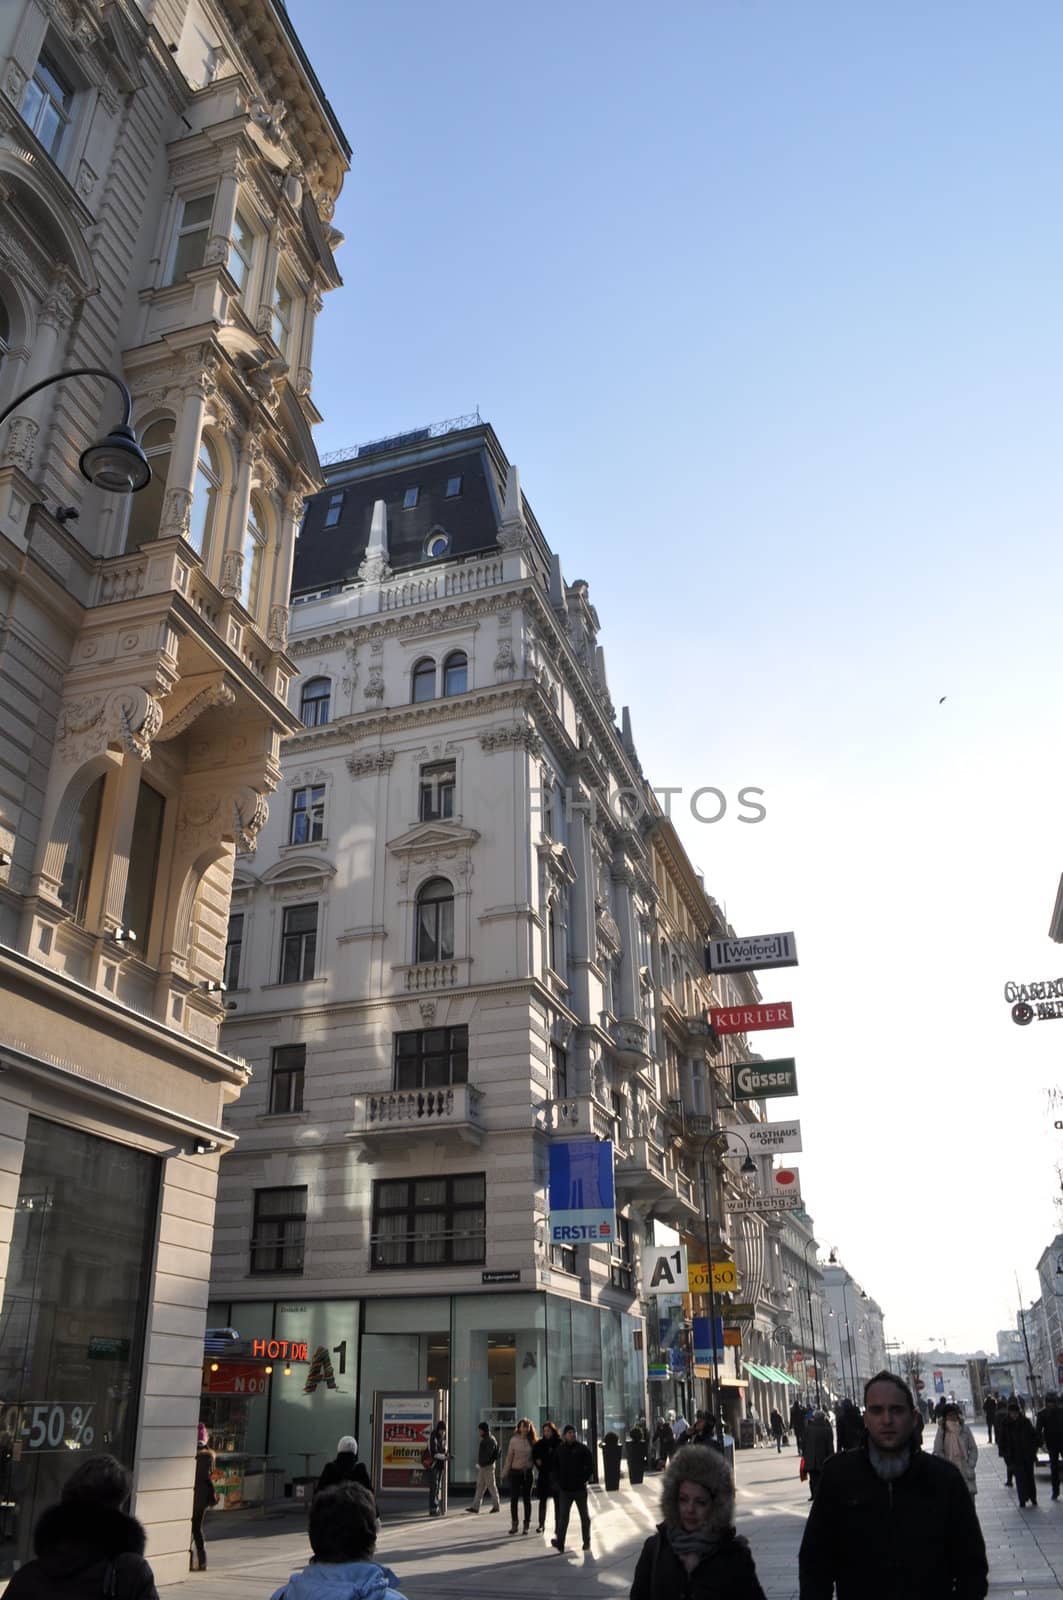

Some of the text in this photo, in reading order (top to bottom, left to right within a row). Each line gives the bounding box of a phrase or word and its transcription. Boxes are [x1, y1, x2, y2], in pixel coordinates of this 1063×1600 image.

[729, 943, 777, 957] Wolford
[716, 1008, 789, 1027] KURIER
[737, 1066, 793, 1094] Gösser
[749, 1128, 798, 1140] GASTHAUS
[760, 1137, 785, 1146] OPER
[553, 1225, 598, 1240] ERSTE
[650, 1250, 682, 1288] A1
[253, 1338, 289, 1359] HOT
[303, 1340, 346, 1393] A1
